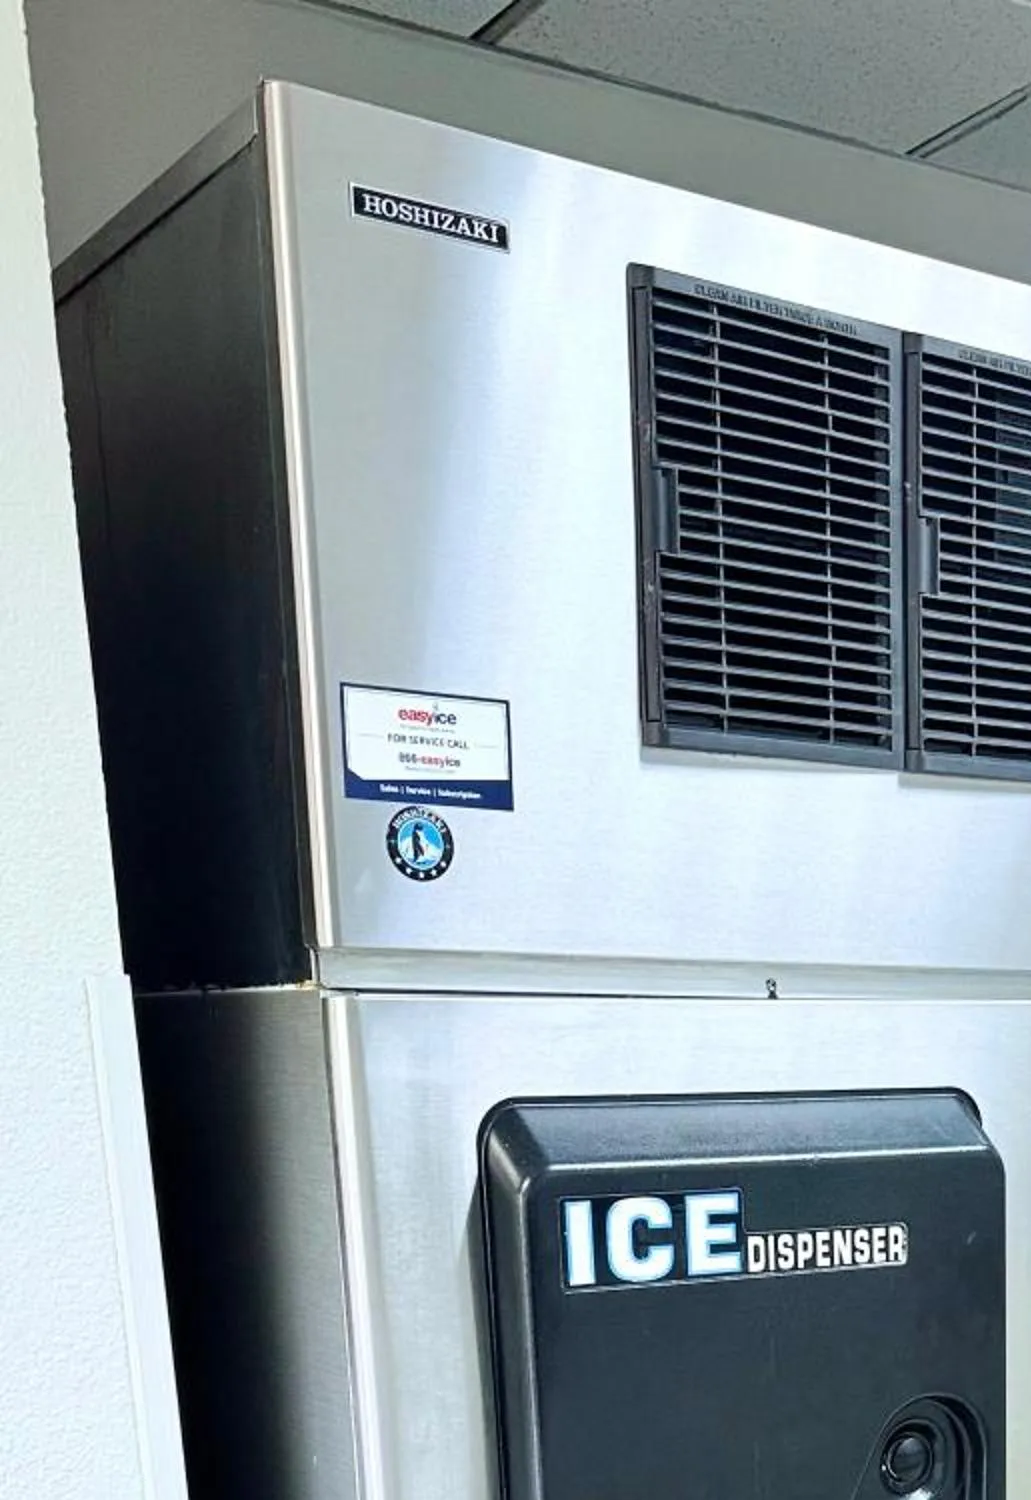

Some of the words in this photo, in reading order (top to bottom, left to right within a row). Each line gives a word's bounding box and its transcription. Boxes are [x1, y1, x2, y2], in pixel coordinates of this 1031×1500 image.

[362, 193, 499, 242] HOSHIZAKI
[398, 707, 457, 726] easyice
[387, 733, 407, 743] FOR
[408, 735, 445, 747] SERVICE
[563, 1192, 743, 1287] ICE
[747, 1225, 905, 1273] DISPENSER
